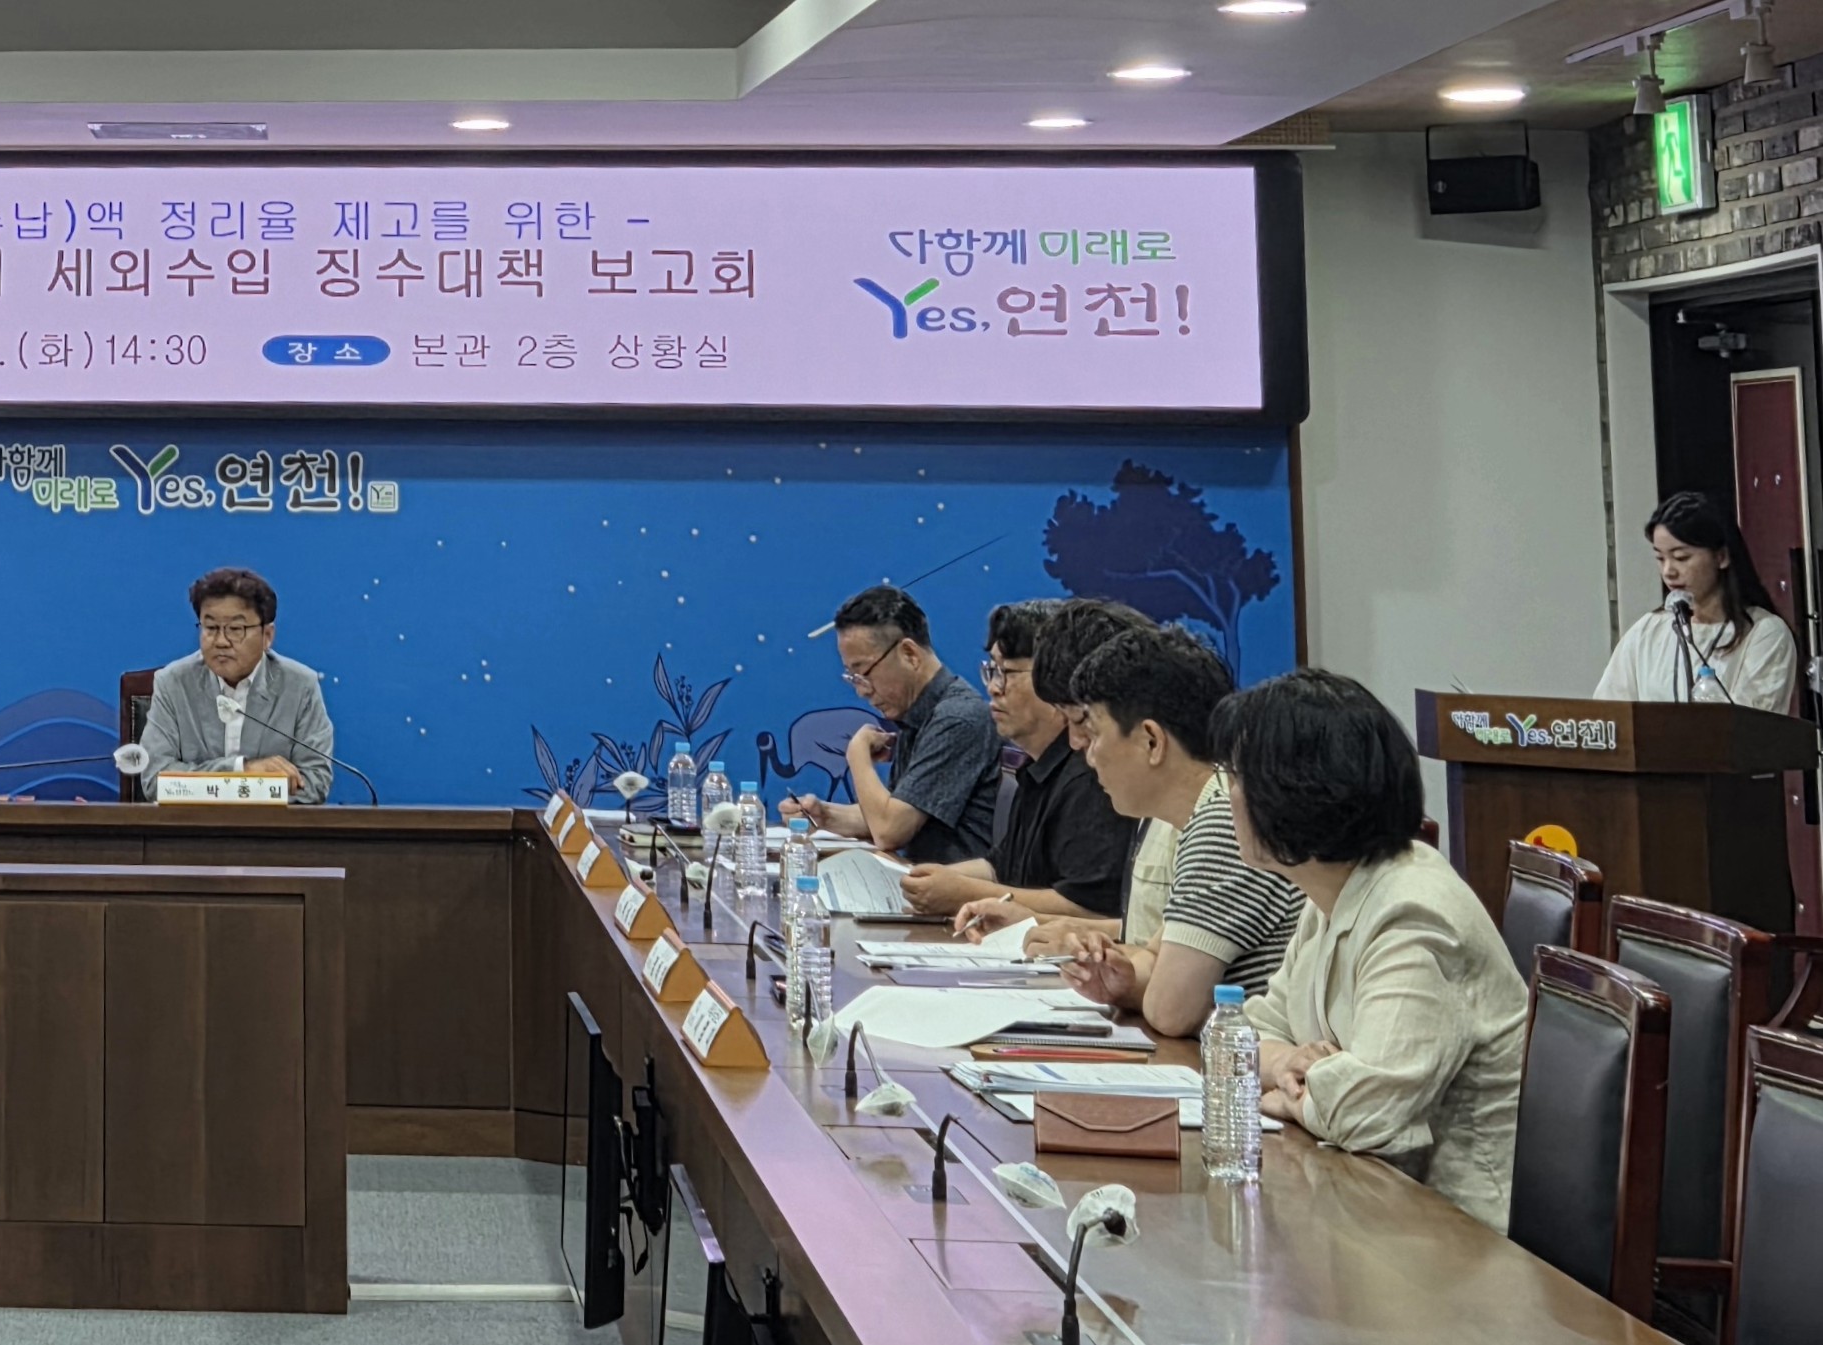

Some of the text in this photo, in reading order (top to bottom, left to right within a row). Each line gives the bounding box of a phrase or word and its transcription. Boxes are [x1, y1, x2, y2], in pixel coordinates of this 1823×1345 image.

[160, 200, 297, 241] 정리율
[333, 200, 470, 241] 제고를
[504, 201, 596, 241] 위한
[47, 248, 270, 297] 세외수입
[316, 248, 543, 298] 징수대책
[587, 249, 754, 298] 보고회
[888, 228, 1177, 277] 다함께 미래로
[853, 277, 1191, 340] Yes, 연천!
[412, 334, 491, 368] 본관
[517, 334, 578, 369] 2층
[608, 334, 727, 370] 상황실
[33, 477, 119, 513] 미래로
[216, 449, 364, 512] 연천!
[1551, 718, 1617, 749] 연천!
